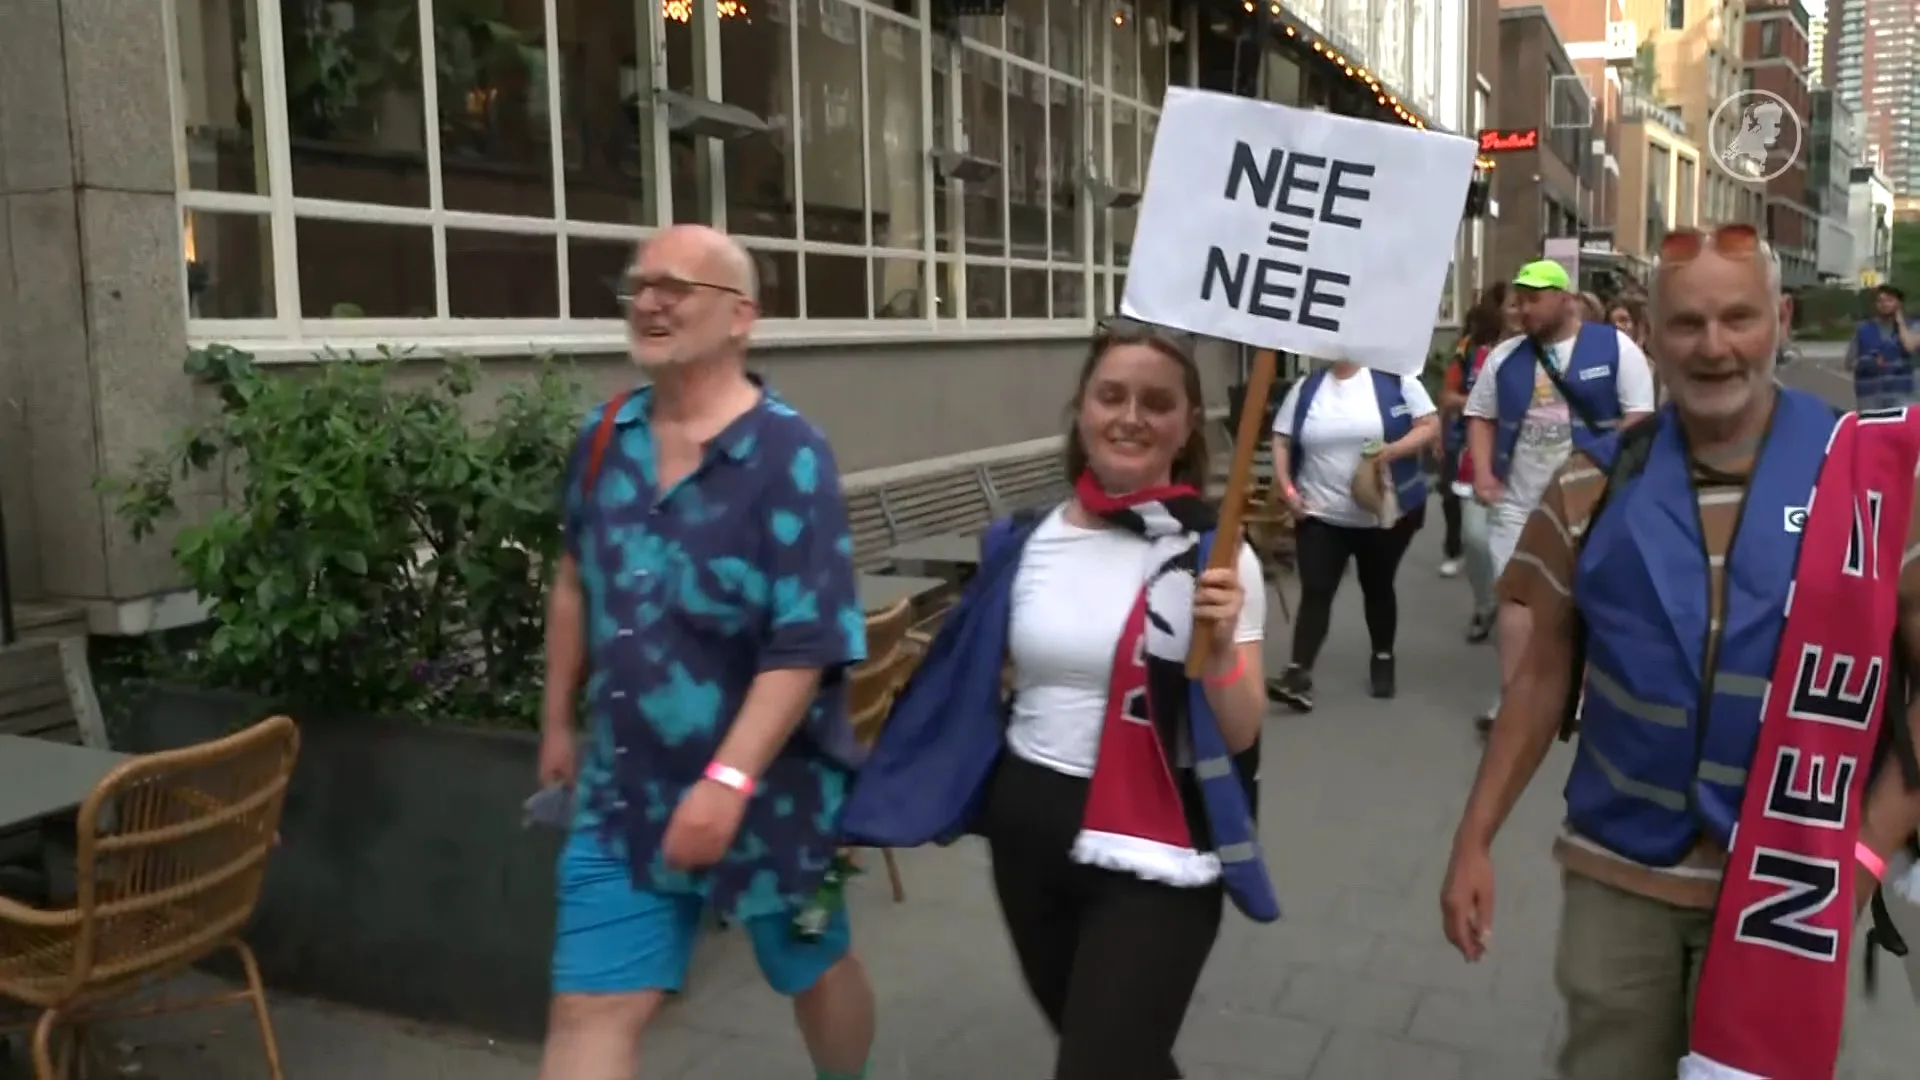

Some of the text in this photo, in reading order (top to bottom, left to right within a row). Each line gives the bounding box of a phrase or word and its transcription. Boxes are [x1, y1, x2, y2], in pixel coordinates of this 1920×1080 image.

[1223, 139, 1376, 230] NEE
[1266, 221, 1310, 252] =
[1200, 245, 1351, 332] NEE
[1734, 642, 1884, 963] NEE
